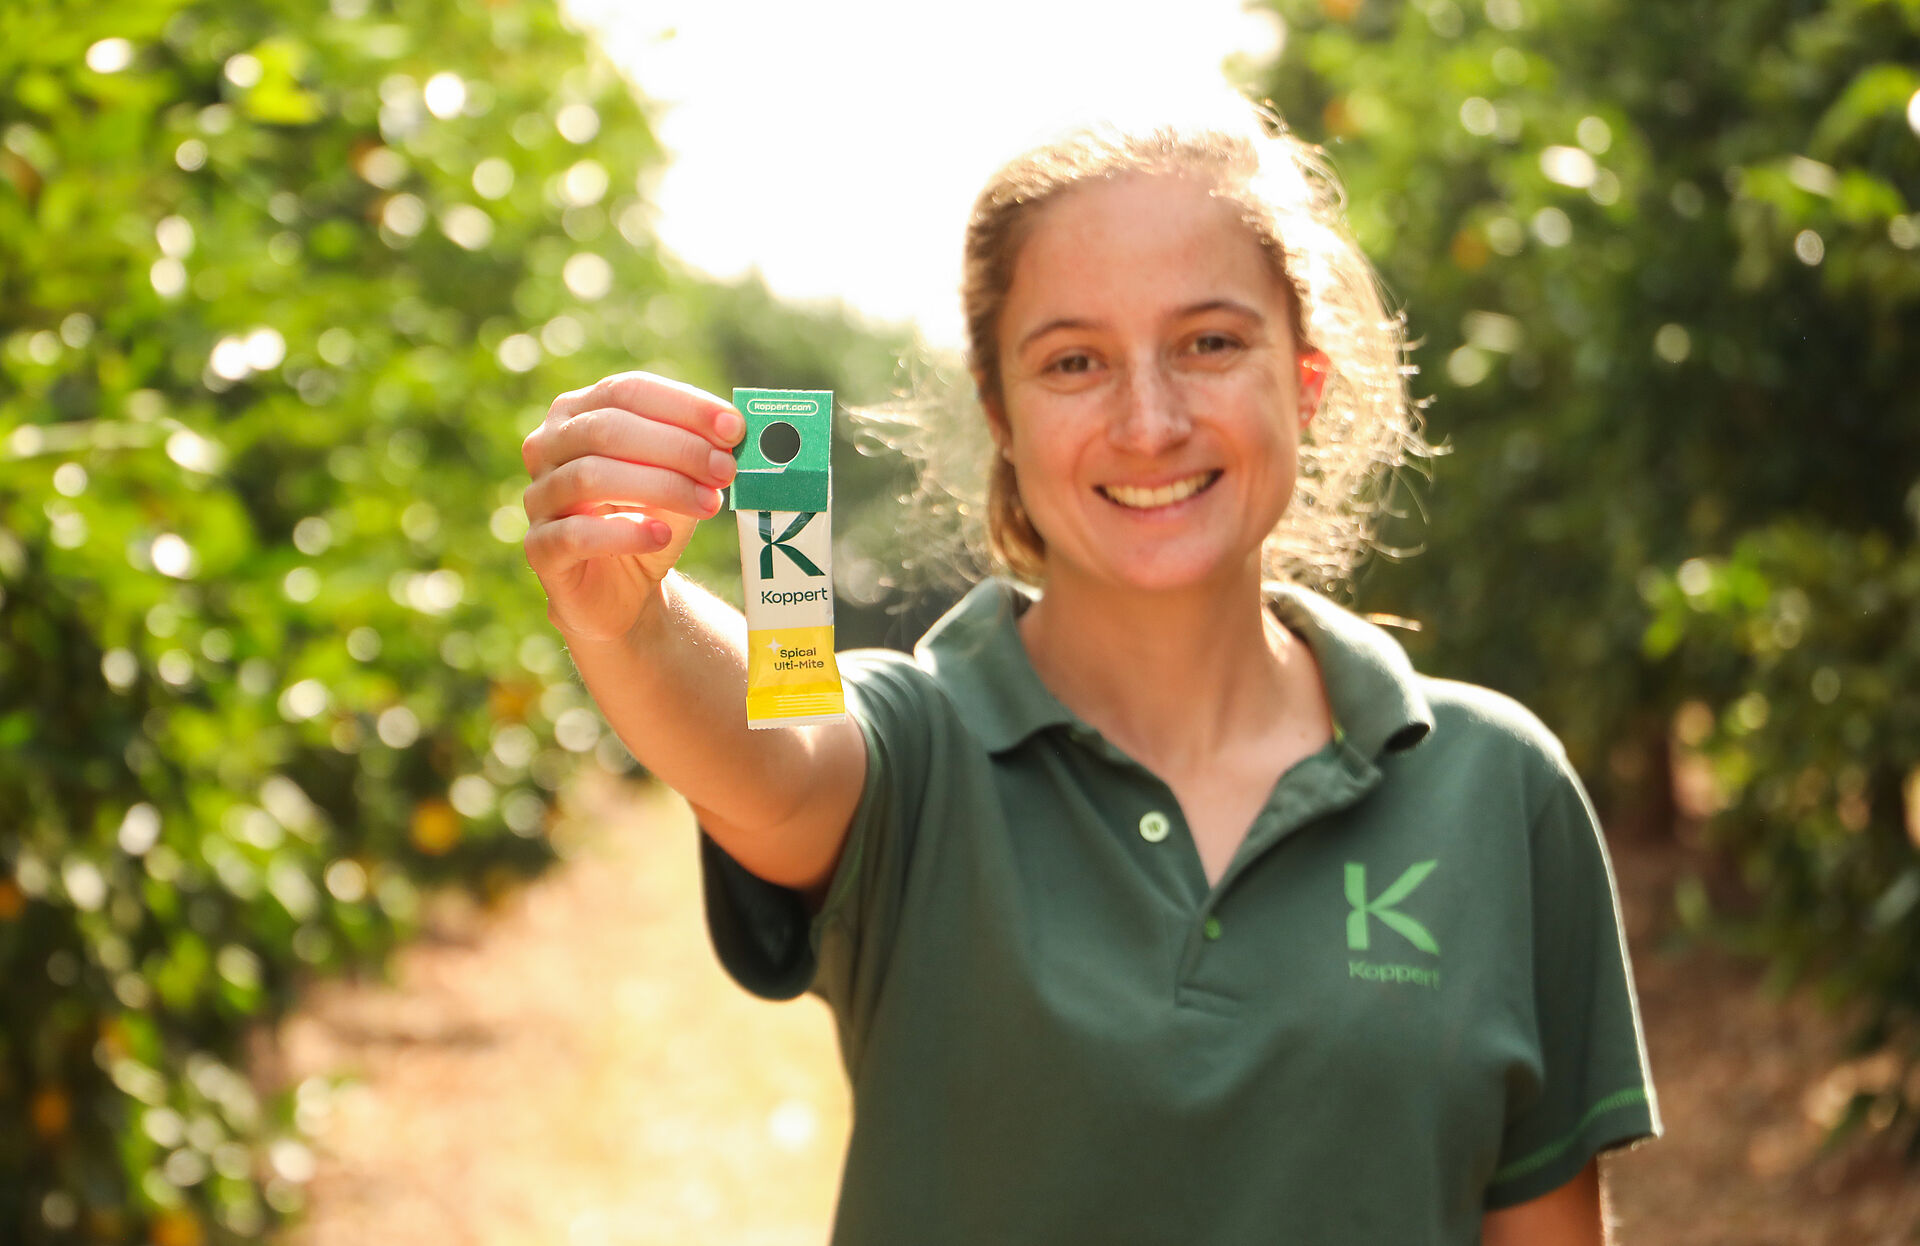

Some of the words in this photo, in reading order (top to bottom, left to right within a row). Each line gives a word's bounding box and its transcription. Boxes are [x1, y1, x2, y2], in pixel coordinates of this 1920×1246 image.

[758, 511, 826, 579] K
[761, 587, 828, 605] Koppert
[774, 659, 824, 671] Ulti-Mite
[780, 647, 816, 659] Spical
[1344, 859, 1440, 956] K
[1348, 960, 1440, 990] Koppert
